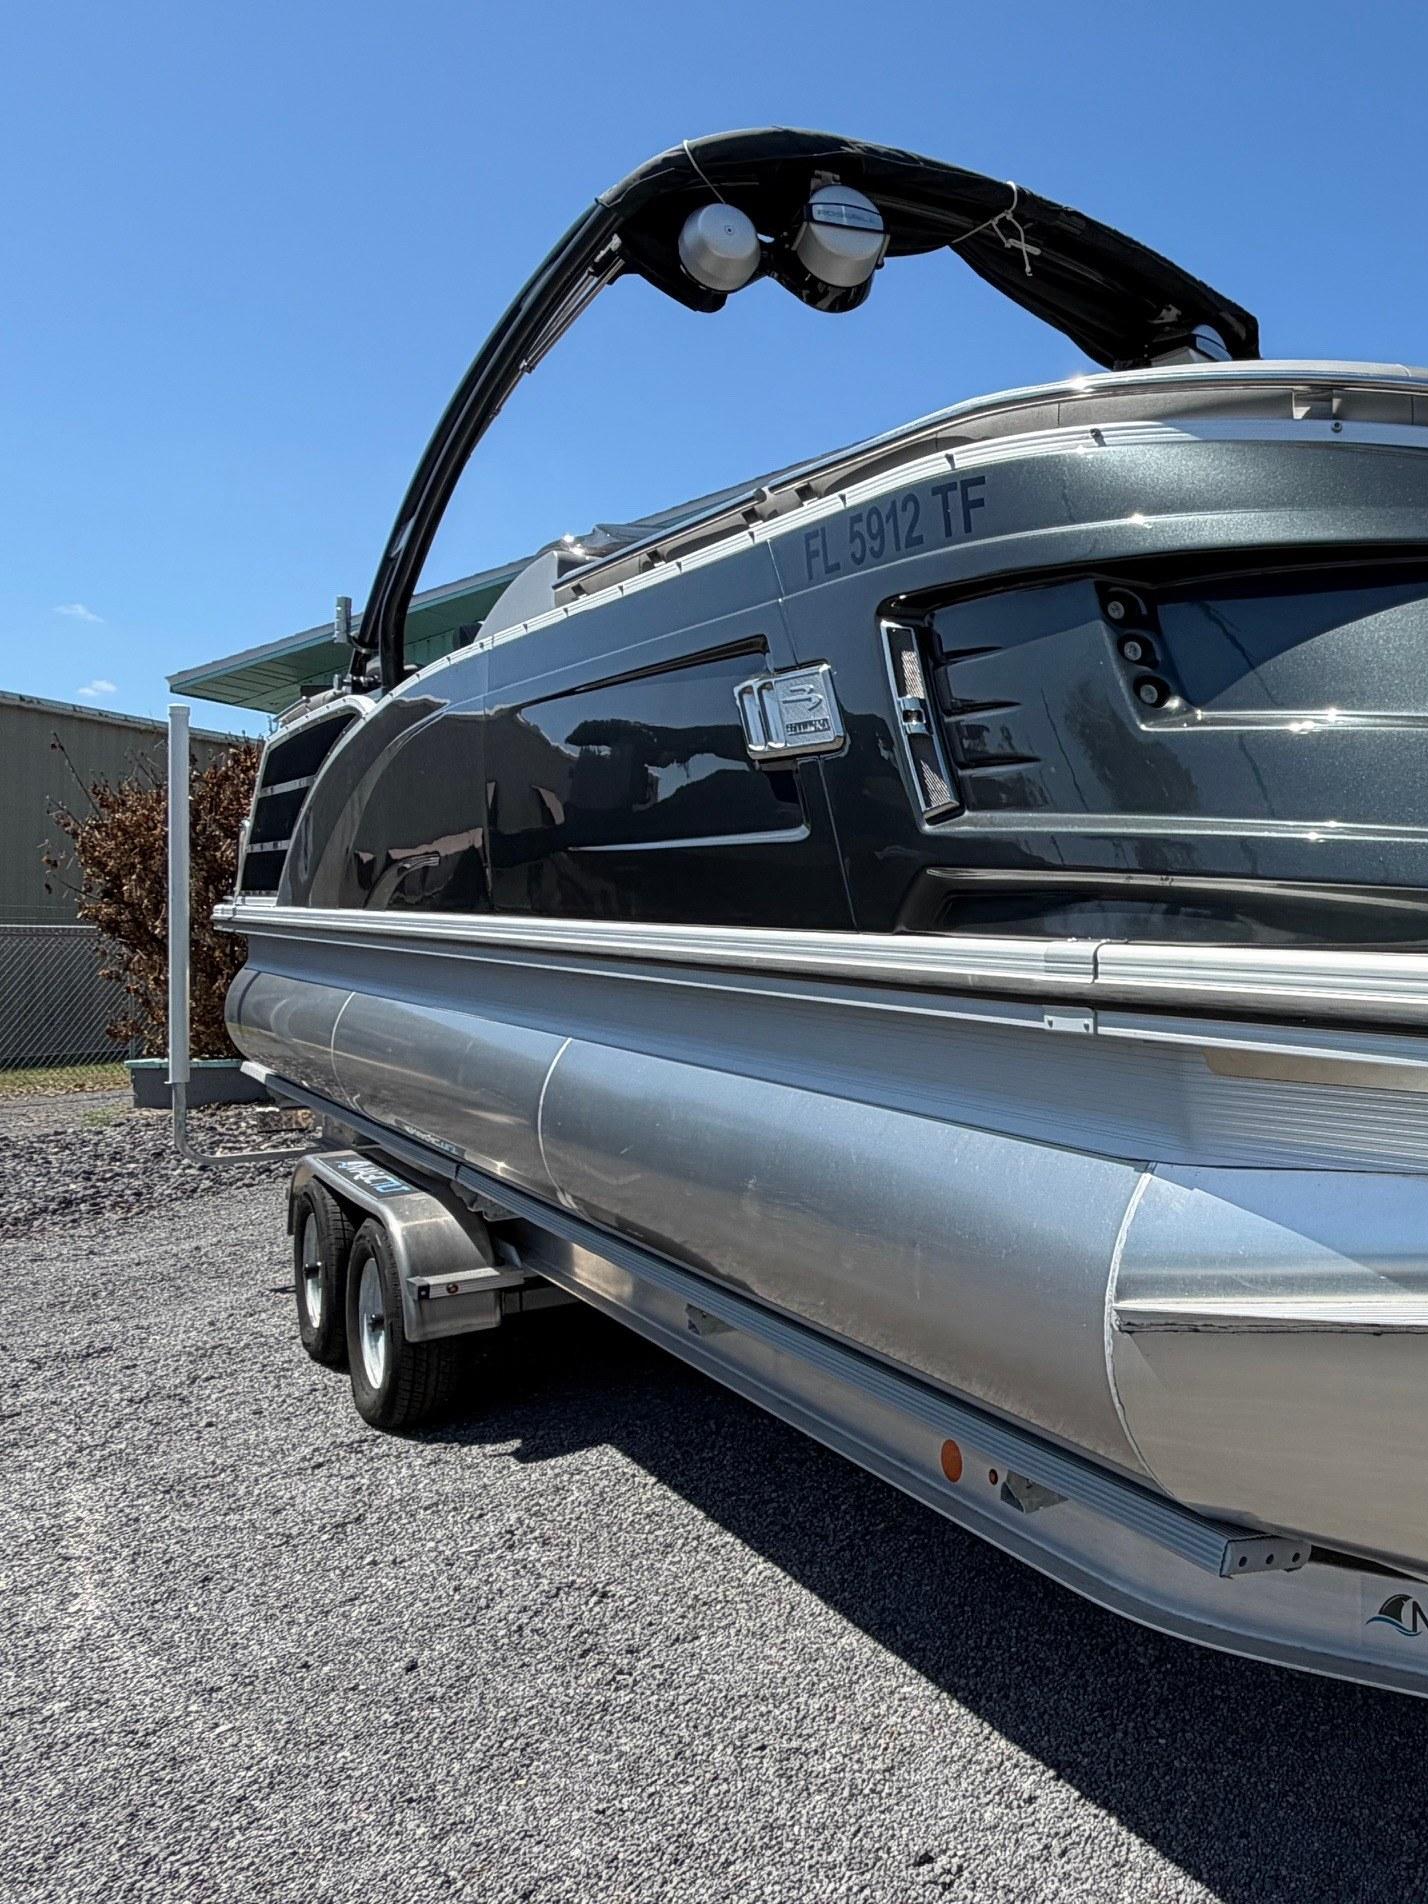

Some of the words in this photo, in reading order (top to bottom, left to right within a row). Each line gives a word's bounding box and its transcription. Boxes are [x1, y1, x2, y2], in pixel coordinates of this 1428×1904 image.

[804, 526, 841, 580] FL
[850, 493, 924, 566] 5912
[931, 475, 986, 538] TF
